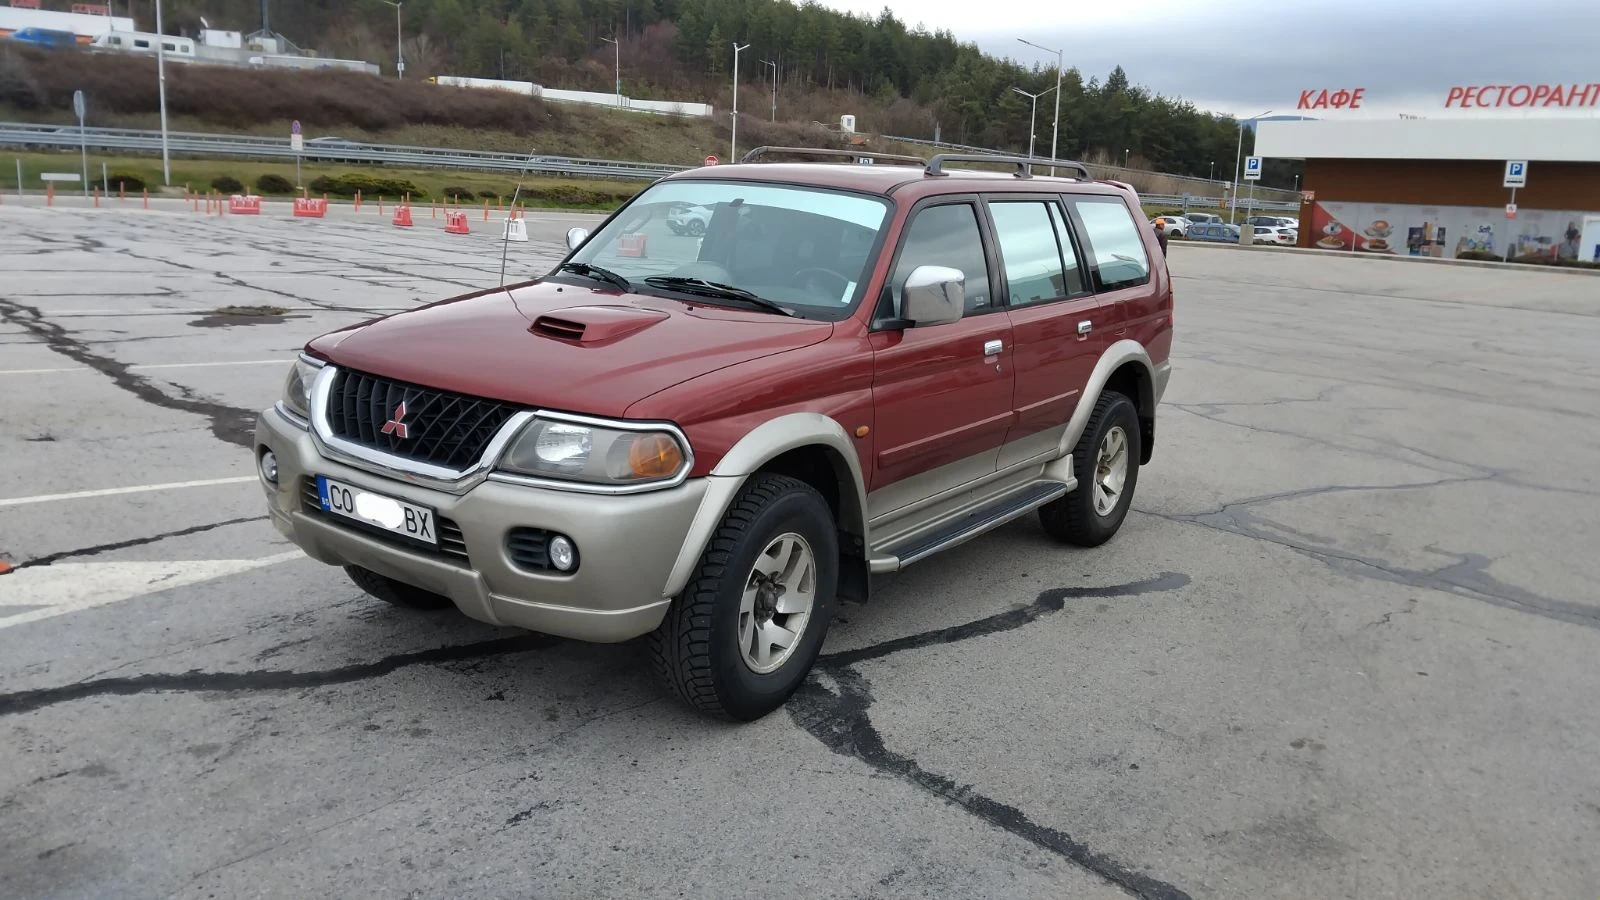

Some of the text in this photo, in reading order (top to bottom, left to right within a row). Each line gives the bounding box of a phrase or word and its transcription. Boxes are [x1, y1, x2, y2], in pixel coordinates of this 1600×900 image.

[1297, 88, 1366, 109] КАФЕ
[1445, 84, 1600, 108] РЕСТОРАНТ
[1250, 159, 1257, 169] P
[1512, 164, 1521, 174] P
[330, 484, 431, 539] CO BX
